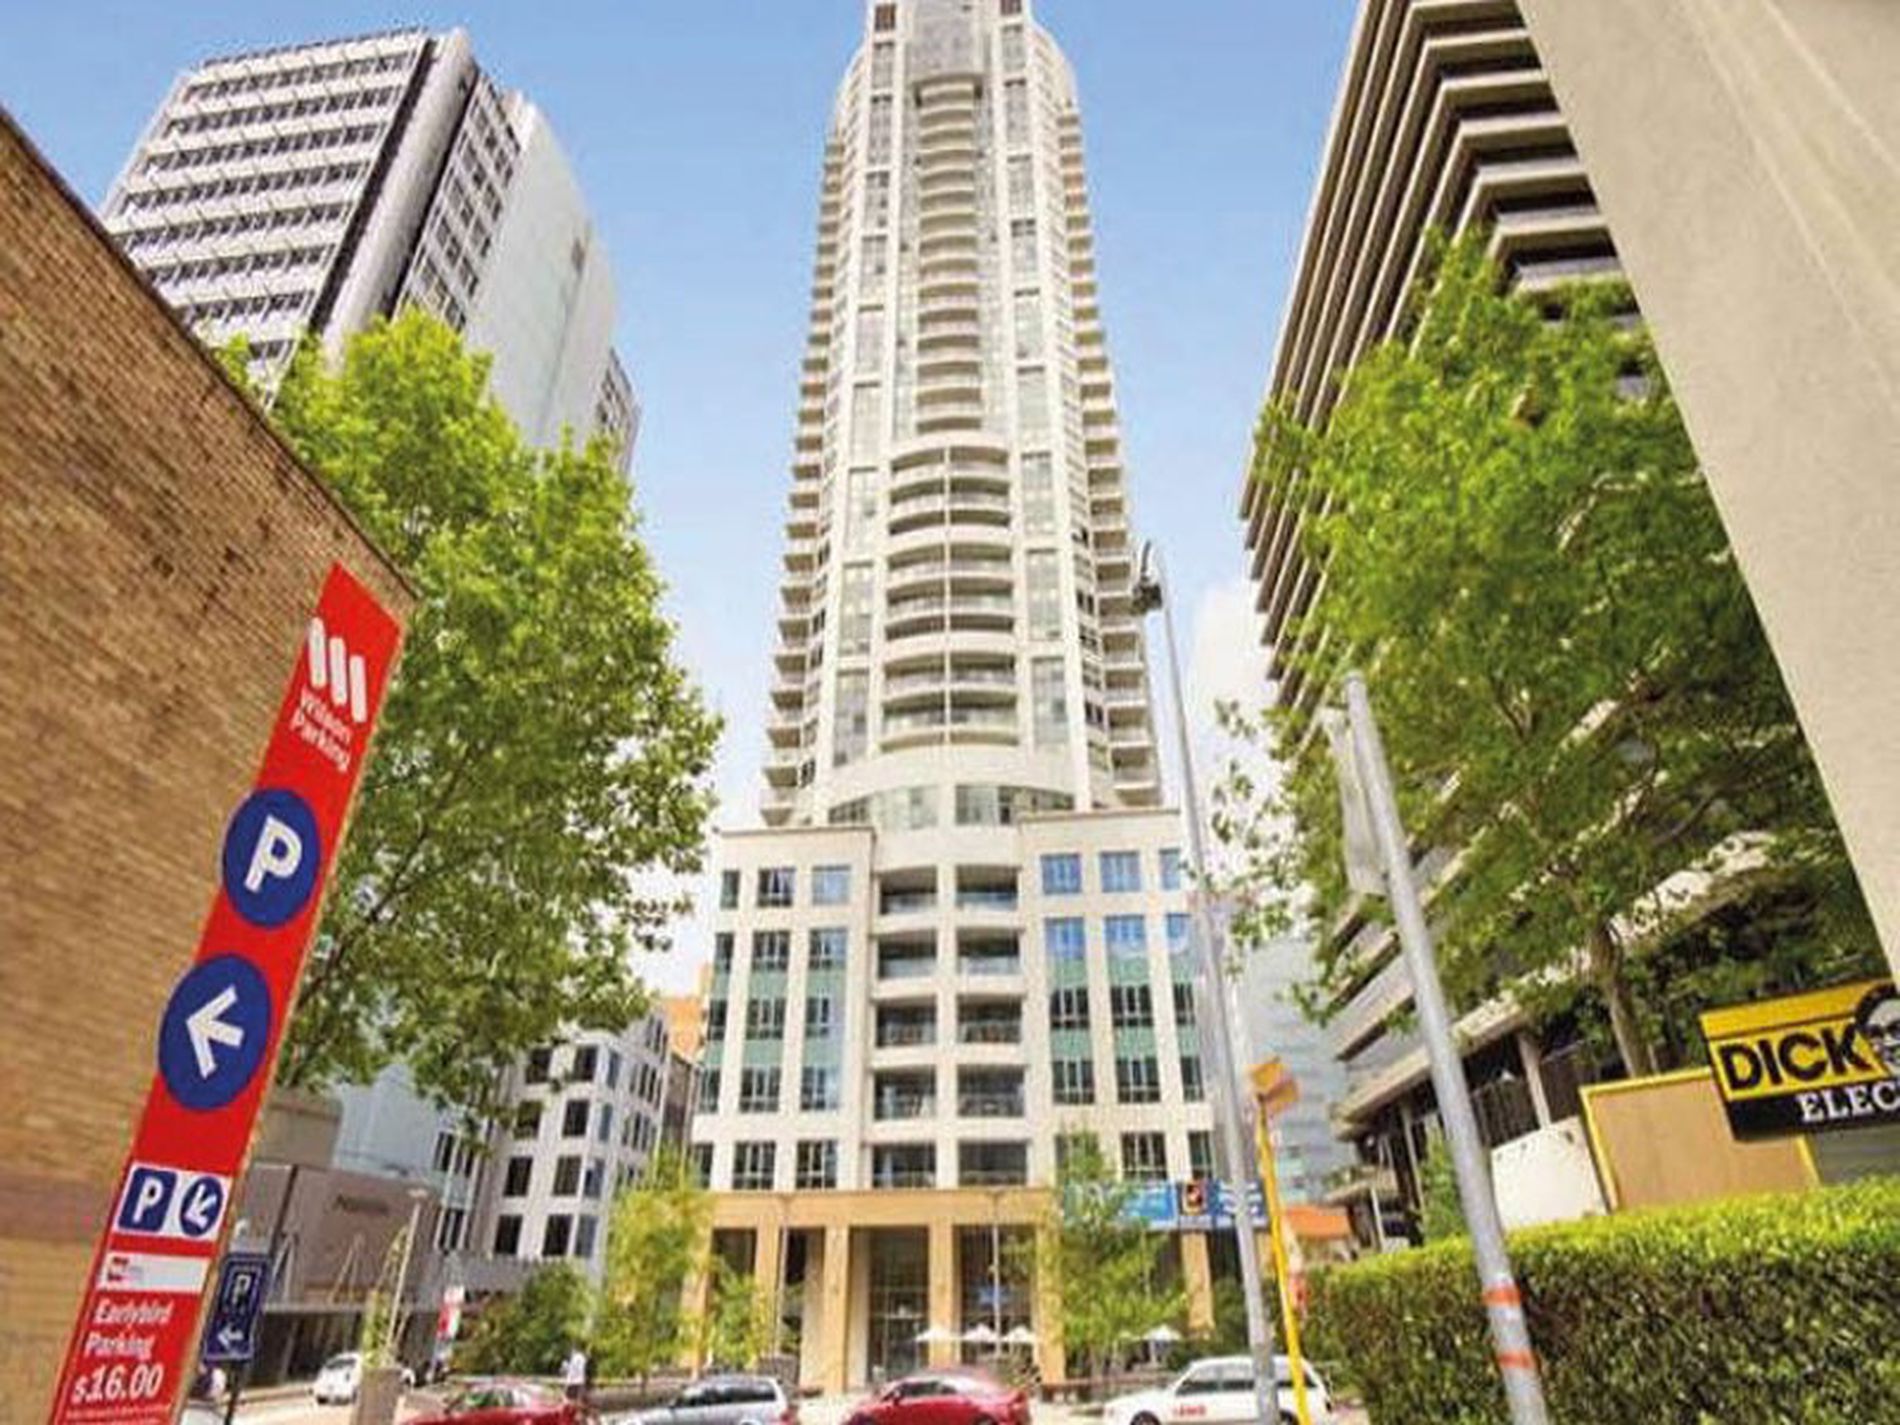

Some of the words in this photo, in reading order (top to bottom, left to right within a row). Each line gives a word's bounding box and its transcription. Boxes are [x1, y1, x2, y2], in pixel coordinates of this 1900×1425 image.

[289, 707, 352, 773] Parking
[300, 683, 354, 745] Wilson
[244, 813, 303, 892] P
[1719, 1023, 1872, 1090] DICK
[132, 1175, 164, 1224] P
[232, 1274, 251, 1304] P
[83, 1331, 155, 1361] Parking
